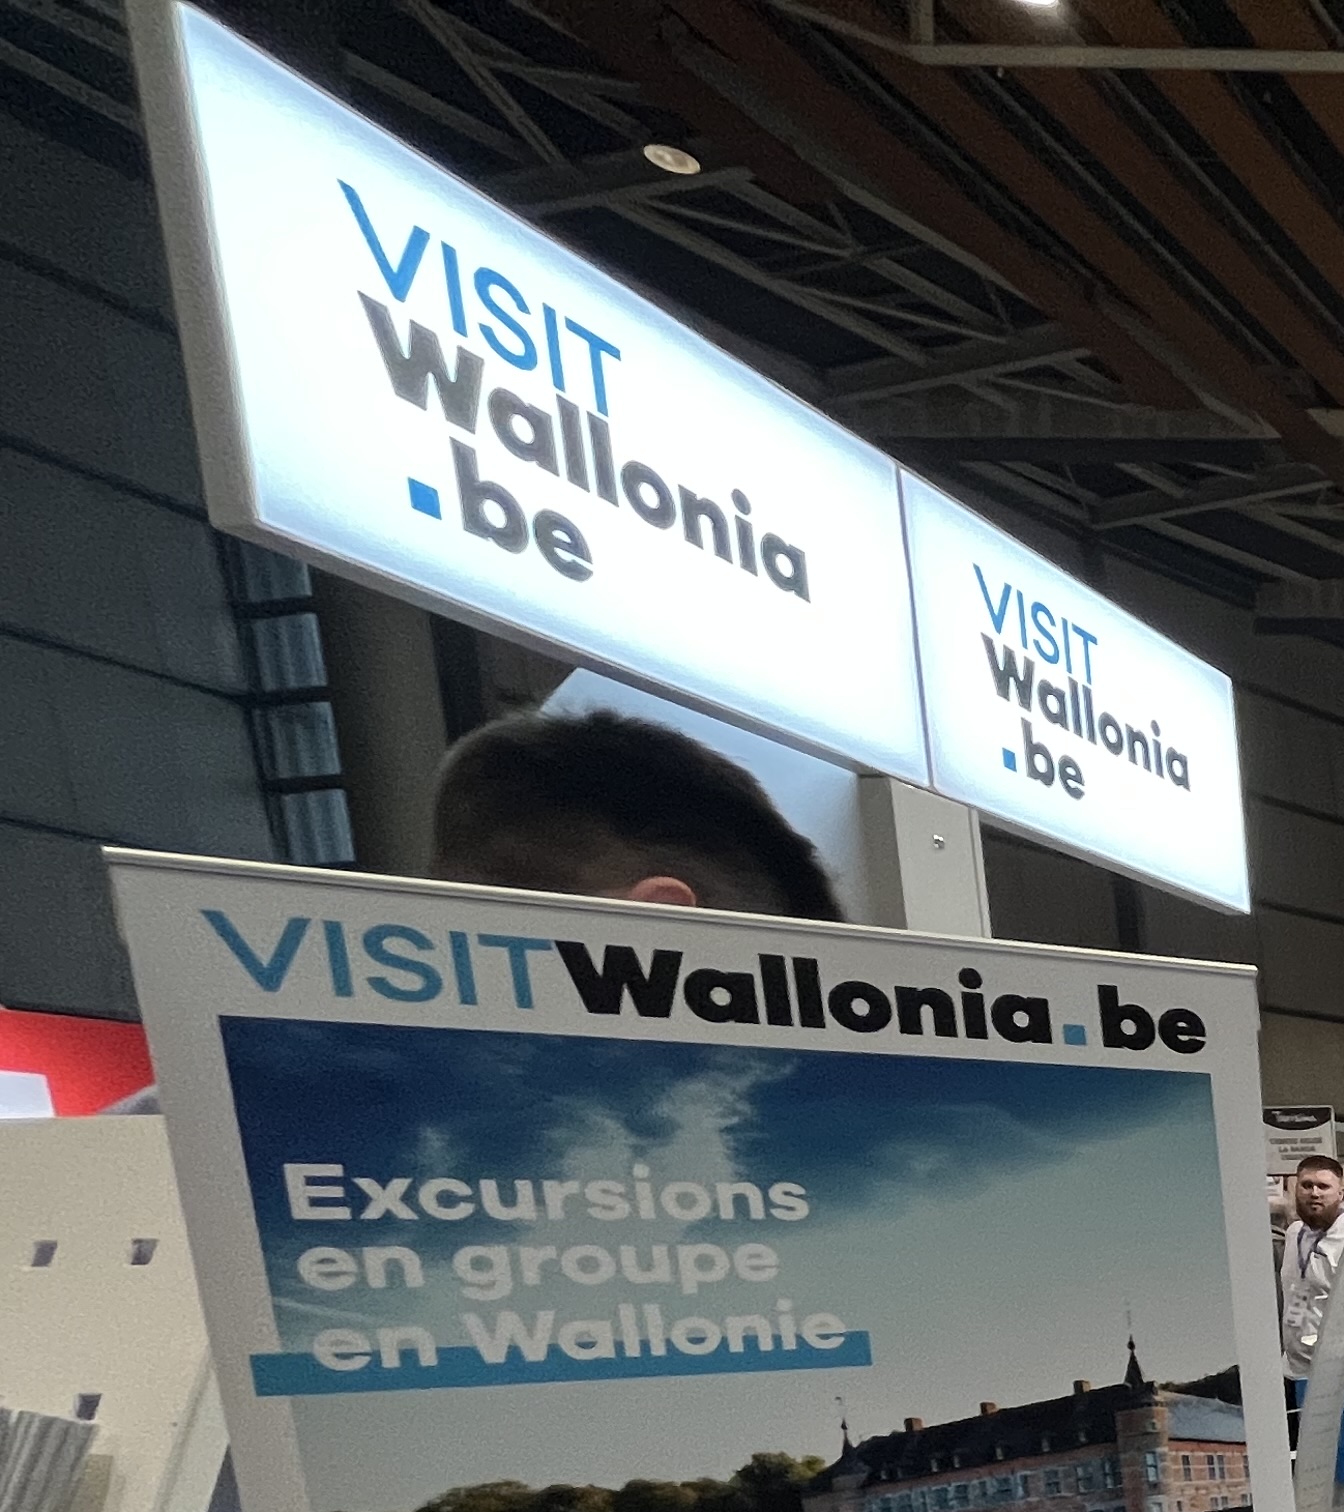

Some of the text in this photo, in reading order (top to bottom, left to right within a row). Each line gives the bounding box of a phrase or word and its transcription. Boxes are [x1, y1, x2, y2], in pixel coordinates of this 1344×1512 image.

[338, 179, 621, 416] VISIT
[357, 292, 811, 602] Wallonia
[407, 437, 593, 582] .be
[973, 564, 1098, 682] VISIT
[981, 632, 1190, 791] Wallonia
[1001, 738, 1085, 800] .be
[201, 909, 1206, 1055] VISITWallonia.be
[284, 1162, 810, 1224] Excursions
[297, 1237, 781, 1302] en groupe
[313, 1301, 848, 1374] en Wallonie
